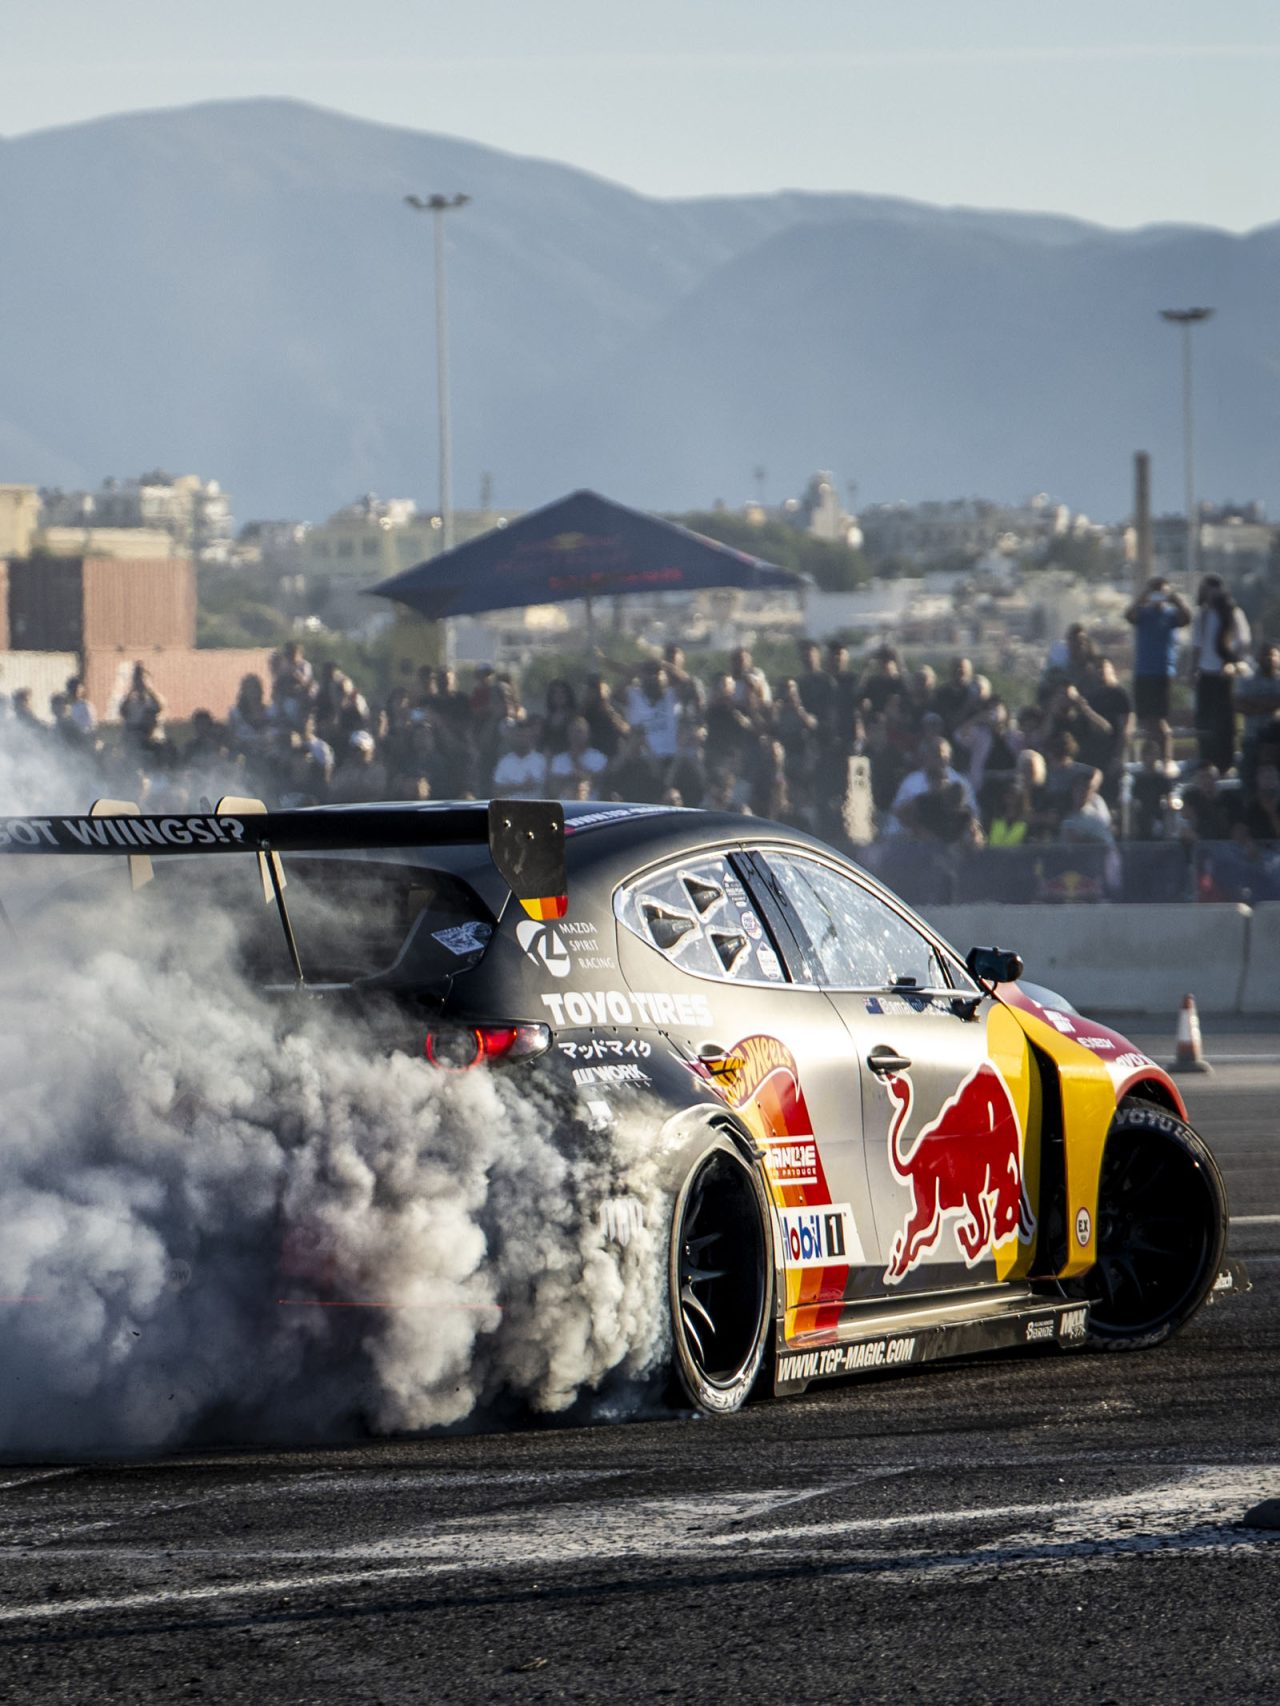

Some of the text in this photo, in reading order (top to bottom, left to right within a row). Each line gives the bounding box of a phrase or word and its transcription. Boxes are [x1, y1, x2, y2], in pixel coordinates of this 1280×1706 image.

[63, 817, 246, 846] WIINGS!?
[559, 922, 598, 935] MAZDA
[569, 939, 599, 952] SPIRIT
[577, 957, 616, 970] RACING
[541, 991, 714, 1028] TOYO TIRES
[558, 1039, 652, 1060] マッドマイク
[592, 1063, 649, 1082] WORK
[827, 1214, 841, 1255] 1
[777, 1337, 916, 1383] WWW.TCP-MAGIC.COM
